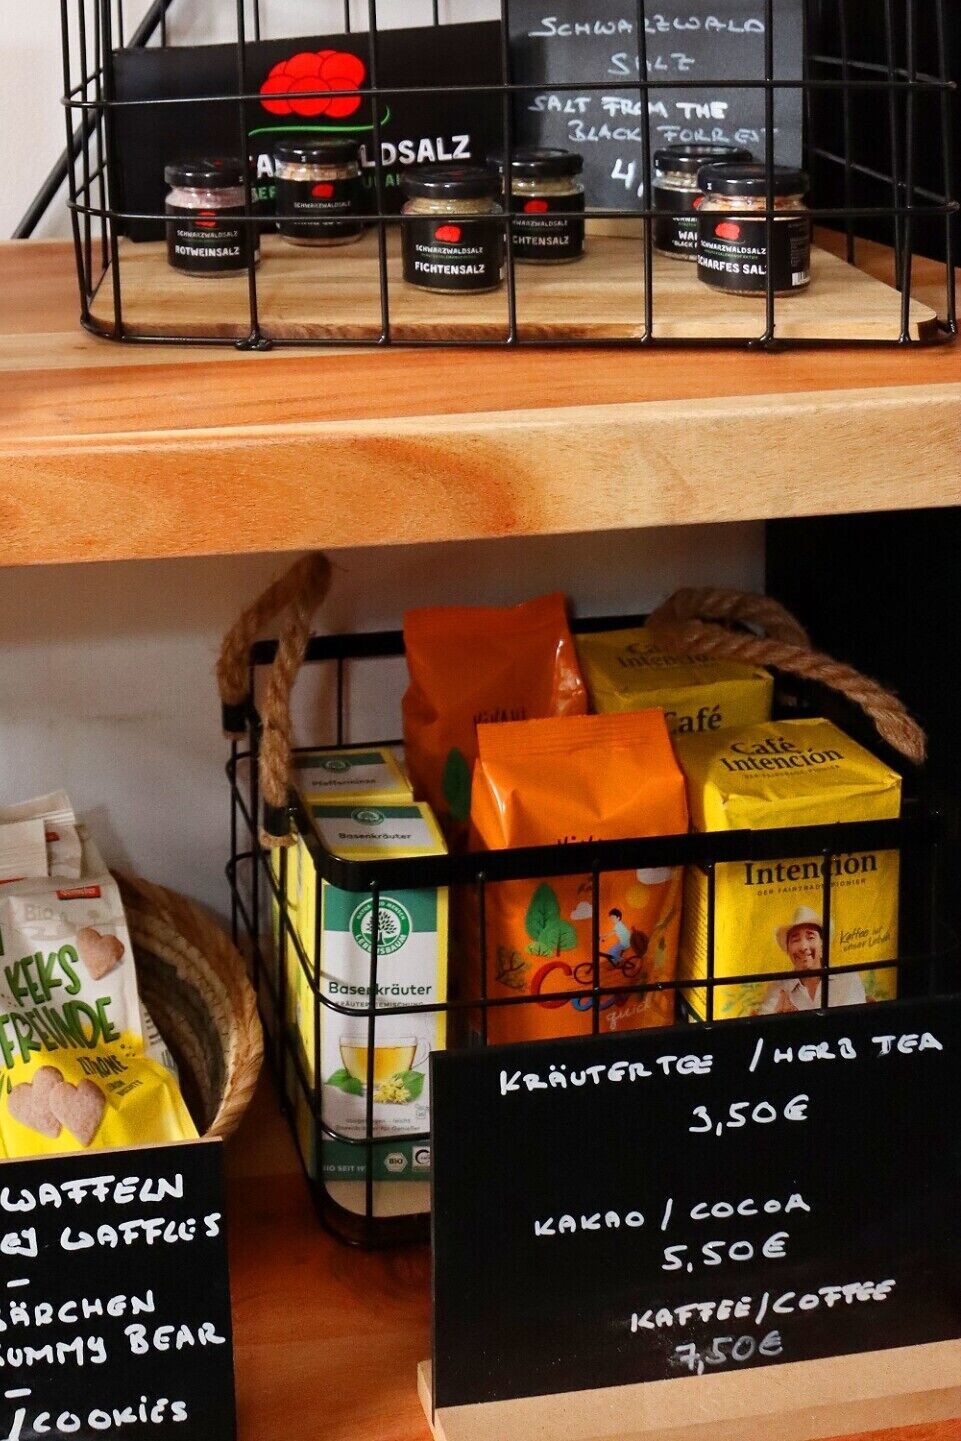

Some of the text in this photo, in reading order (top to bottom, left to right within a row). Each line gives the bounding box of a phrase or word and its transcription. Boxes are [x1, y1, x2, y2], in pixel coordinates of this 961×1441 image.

[676, 101, 729, 120] THE
[174, 244, 241, 258] ROTWEINSALZ
[415, 244, 484, 255] SCHWARZWALDSALZ
[513, 234, 570, 247] CHTENSALZ
[414, 260, 486, 275] FICHTENSALZ
[742, 263, 767, 276] SAL
[730, 736, 802, 755] Café
[719, 748, 845, 772] Intención
[777, 882, 824, 894] FAIRTRAD
[4, 943, 82, 1008] KEKS
[328, 981, 433, 996] Basekräuter
[871, 1031, 944, 1057] TEA
[688, 1094, 809, 1137] 3,50€
[533, 1209, 645, 1237] KAKAO
[690, 1192, 811, 1221] COCOA
[60, 1212, 223, 1252] WAFFLES
[660, 1230, 790, 1272] 5,50€
[123, 1322, 227, 1356] BEAR
[674, 1330, 784, 1376] 7,50€
